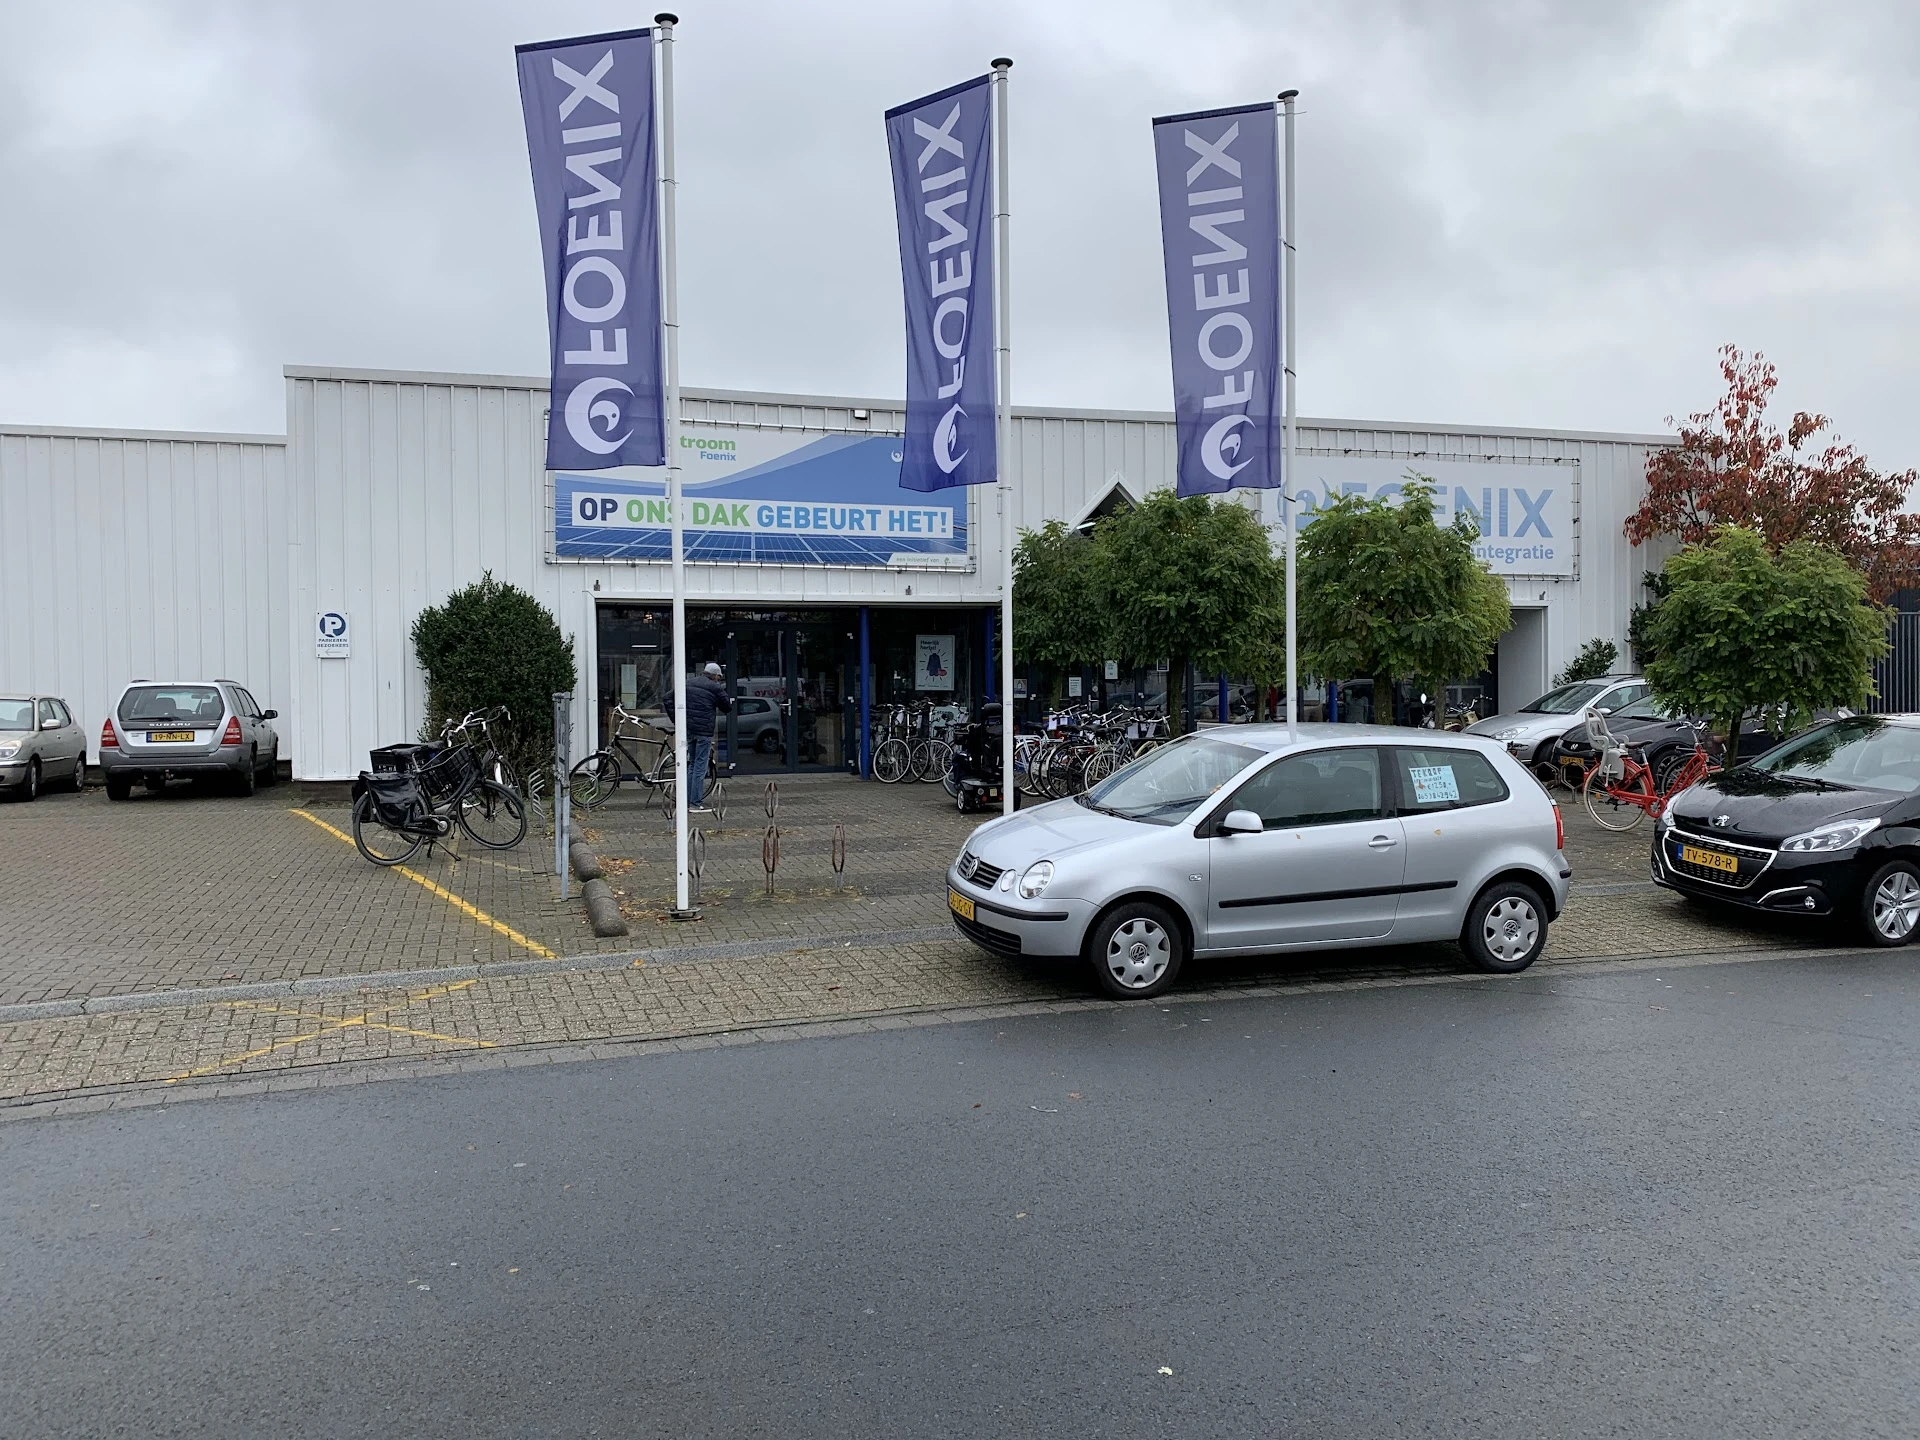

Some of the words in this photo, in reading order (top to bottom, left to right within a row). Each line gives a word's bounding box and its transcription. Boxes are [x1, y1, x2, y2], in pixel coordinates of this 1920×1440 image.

[680, 435, 736, 450] troom
[700, 451, 736, 461] Foenix
[579, 497, 619, 522] OP
[692, 502, 750, 527] DAK
[757, 505, 881, 531] GEBEURT
[888, 510, 947, 533] HET!
[154, 732, 190, 741] 19-NN-LX
[1686, 848, 1733, 870] TV-578-R
